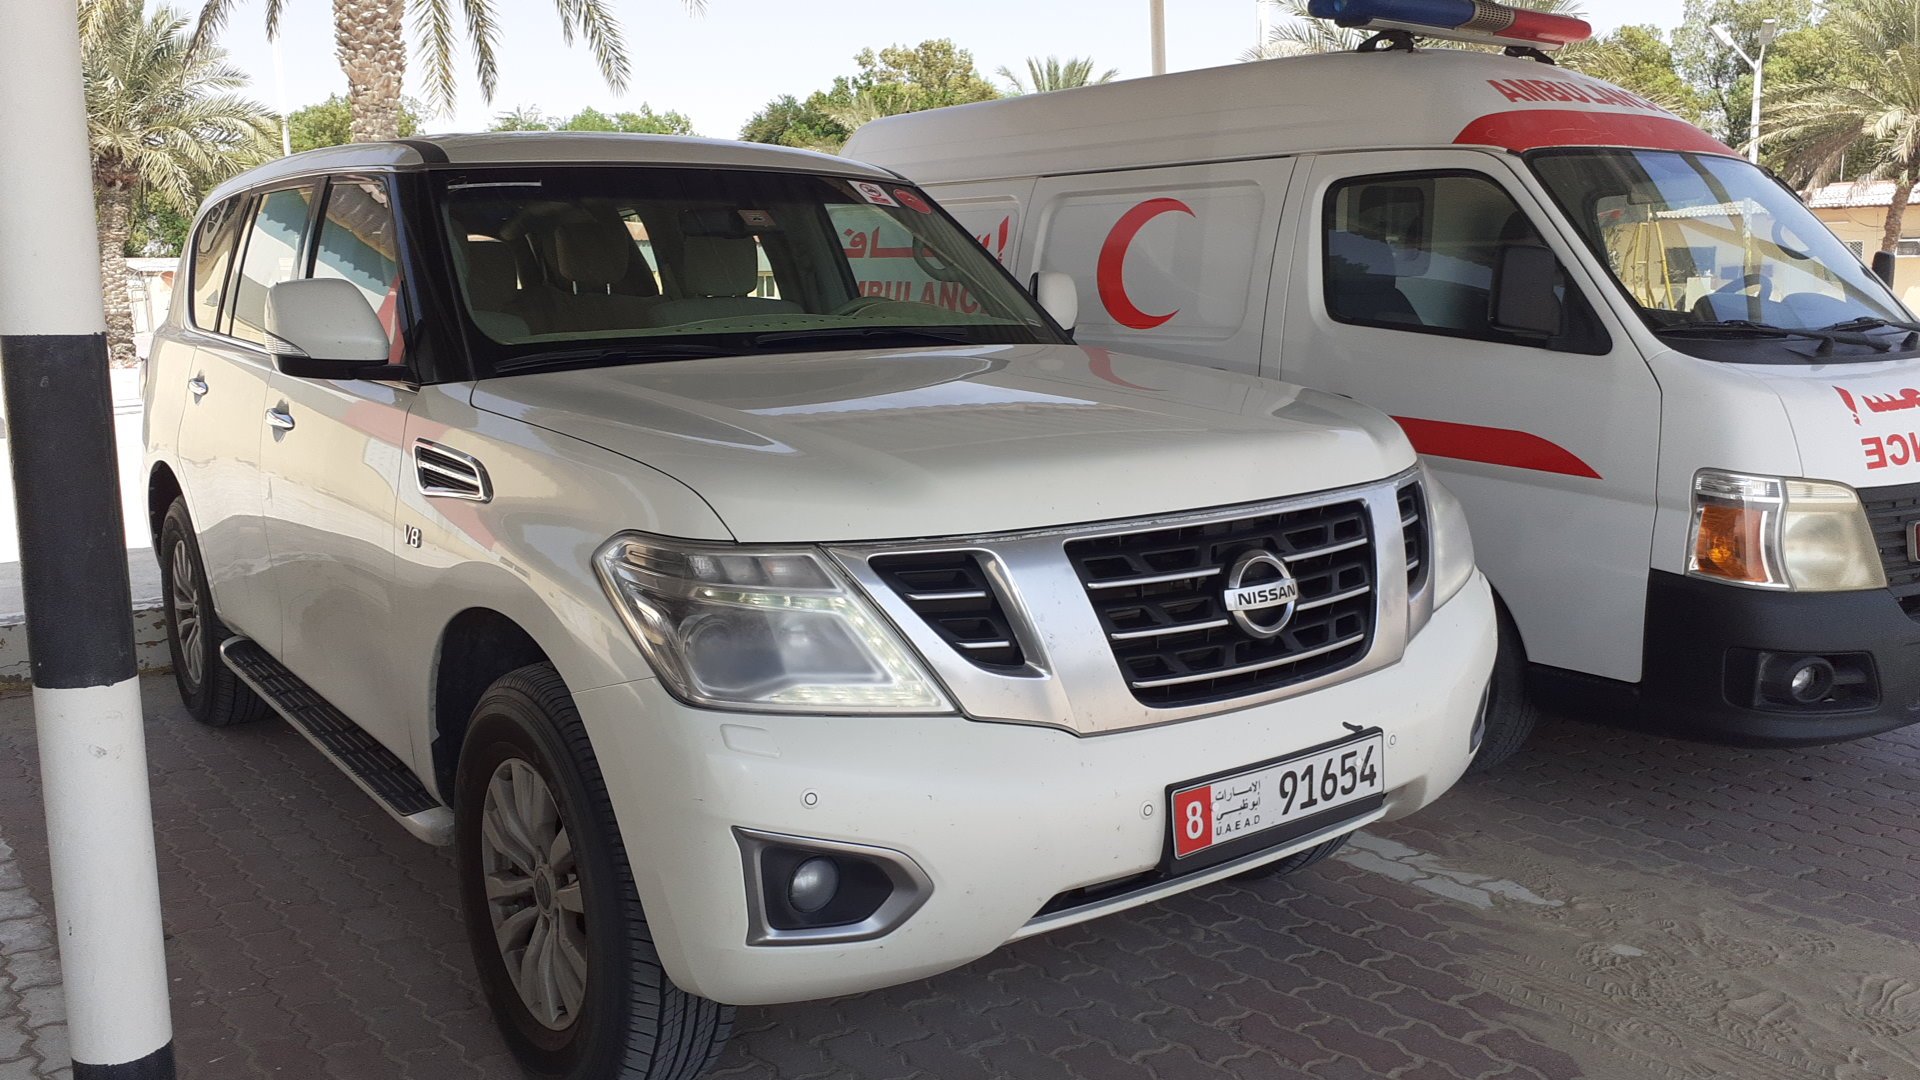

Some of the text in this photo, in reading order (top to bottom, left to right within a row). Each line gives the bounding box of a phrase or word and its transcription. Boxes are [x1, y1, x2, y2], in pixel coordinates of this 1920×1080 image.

[404, 524, 423, 549] V8
[1238, 584, 1296, 605] NISSAN
[1279, 745, 1377, 816] 91654
[1186, 801, 1204, 840] 8
